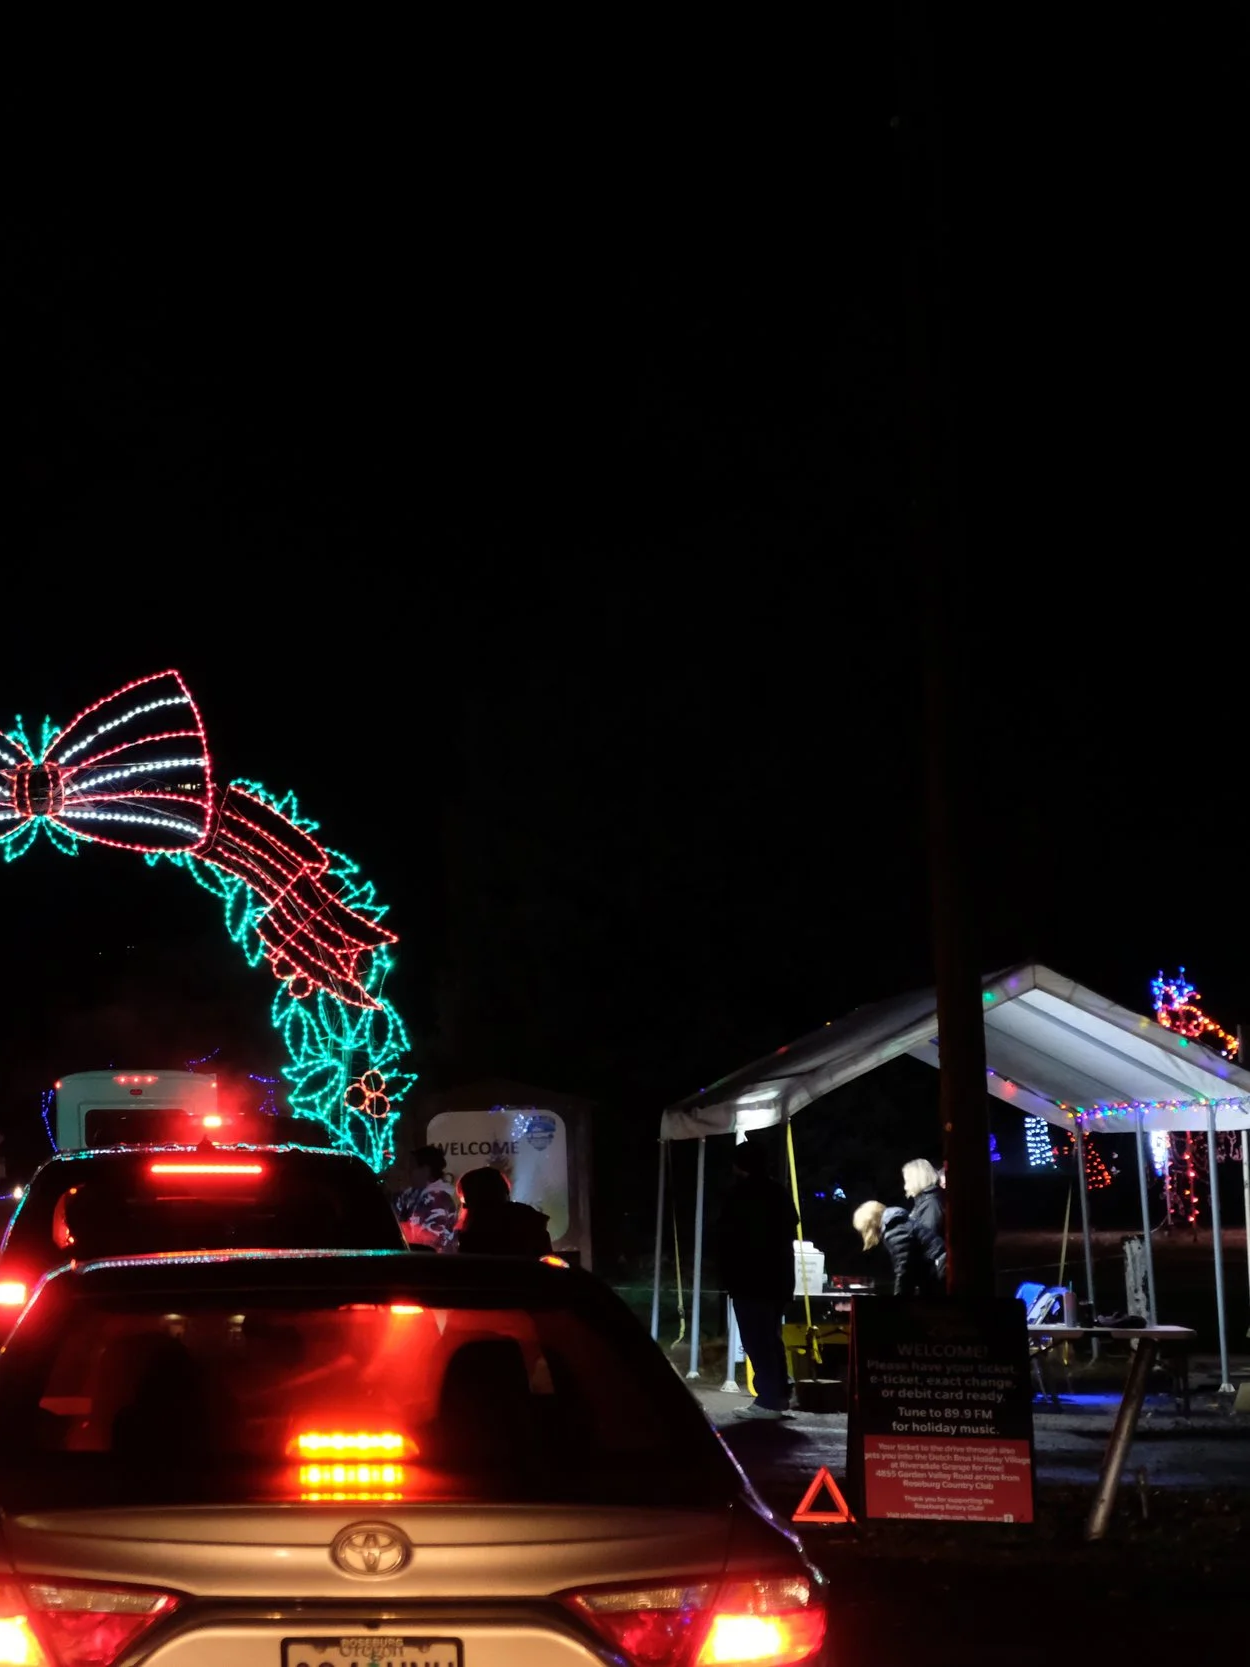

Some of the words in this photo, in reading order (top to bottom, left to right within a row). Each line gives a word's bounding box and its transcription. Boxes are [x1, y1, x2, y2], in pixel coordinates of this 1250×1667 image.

[897, 1342, 989, 1358] WELCOME!
[866, 1359, 909, 1371] Please
[911, 1361, 943, 1373] have
[945, 1364, 974, 1375] your
[870, 1374, 924, 1387] e-ticket,
[926, 1376, 961, 1387] exact
[881, 1389, 895, 1398] or
[897, 1387, 932, 1399] debit
[934, 1389, 964, 1400] card
[966, 1390, 1006, 1404] ready.
[897, 1405, 927, 1417] Tune
[929, 1407, 942, 1418] to
[944, 1408, 971, 1419] 89.9
[974, 1409, 993, 1419] FM
[892, 1421, 909, 1431] for
[912, 1421, 957, 1435] holiday
[959, 1424, 1000, 1435] music.
[878, 1443, 896, 1451] Your
[897, 1443, 919, 1451] ticket
[945, 1445, 965, 1453] drive
[966, 1446, 997, 1455] through
[864, 1452, 880, 1460] gets
[929, 1453, 952, 1461] Dutch
[953, 1454, 971, 1462] Bros
[973, 1455, 1003, 1464] Holiday
[1004, 1456, 1031, 1466] Village
[890, 1461, 899, 1469] at
[941, 1462, 970, 1471] Grange
[898, 1470, 927, 1478] Garden
[928, 1472, 951, 1480] Valley
[953, 1472, 973, 1480] Road
[903, 1480, 940, 1489] Roseburg
[942, 1481, 974, 1490] Country
[975, 1482, 994, 1490] Club
